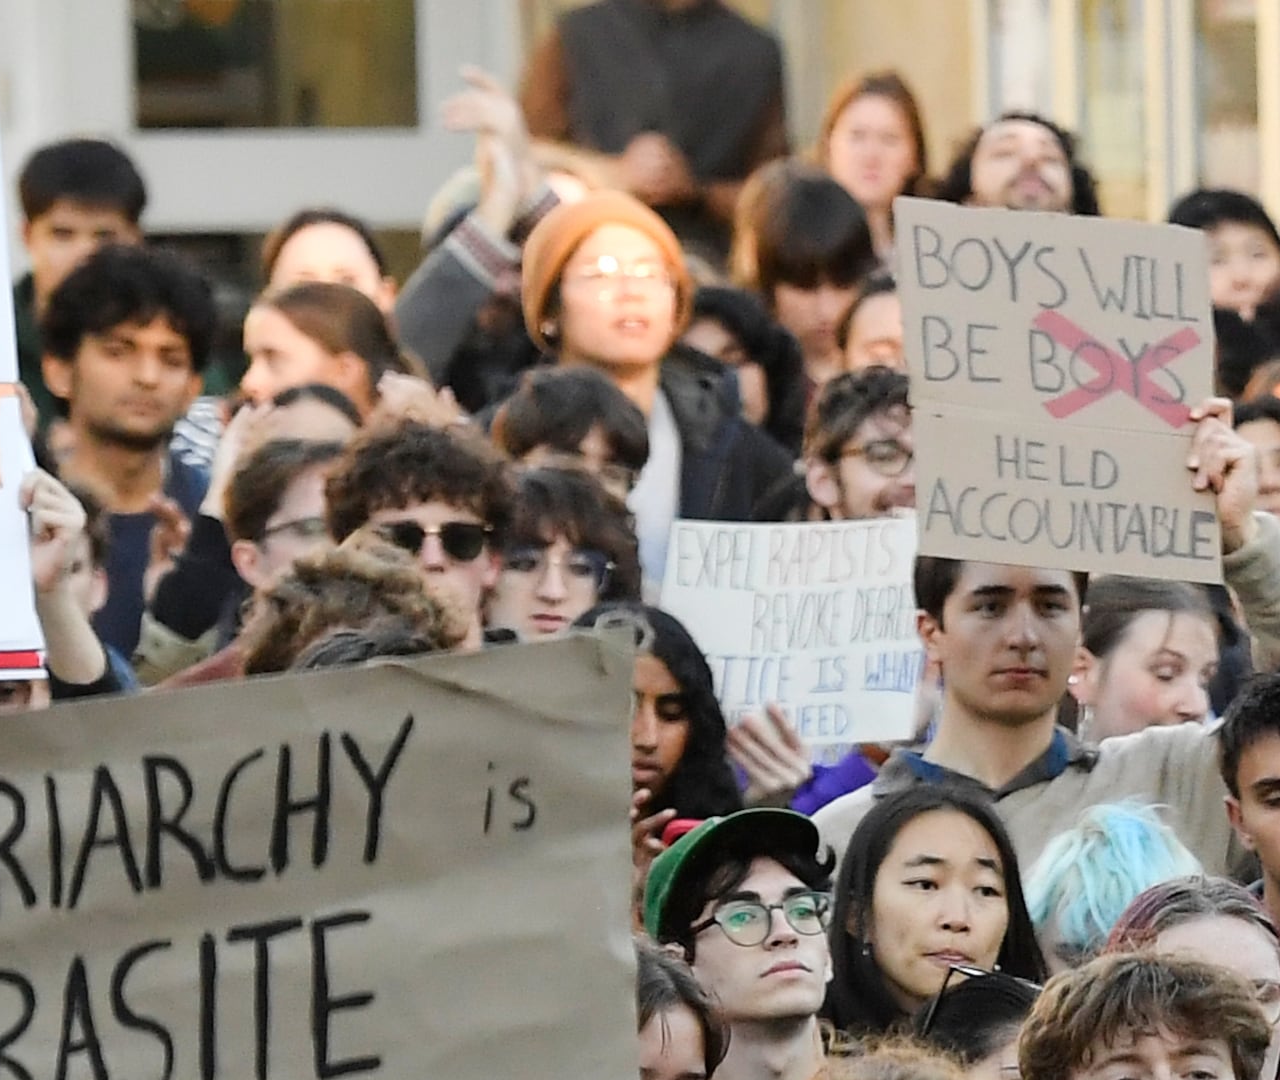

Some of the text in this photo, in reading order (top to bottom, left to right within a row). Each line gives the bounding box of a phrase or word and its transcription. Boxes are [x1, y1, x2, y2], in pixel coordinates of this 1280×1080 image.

[913, 225, 1198, 323] BOYS WILL
[921, 316, 1186, 405] BE BOYS
[996, 435, 1118, 489] HELD
[926, 479, 1215, 560] ACCOUNTABLE
[676, 524, 899, 590] EXPEL RAPISTS
[751, 591, 844, 652] REVOKE
[810, 656, 847, 693] IS
[795, 703, 849, 737] EED
[482, 761, 537, 834] is
